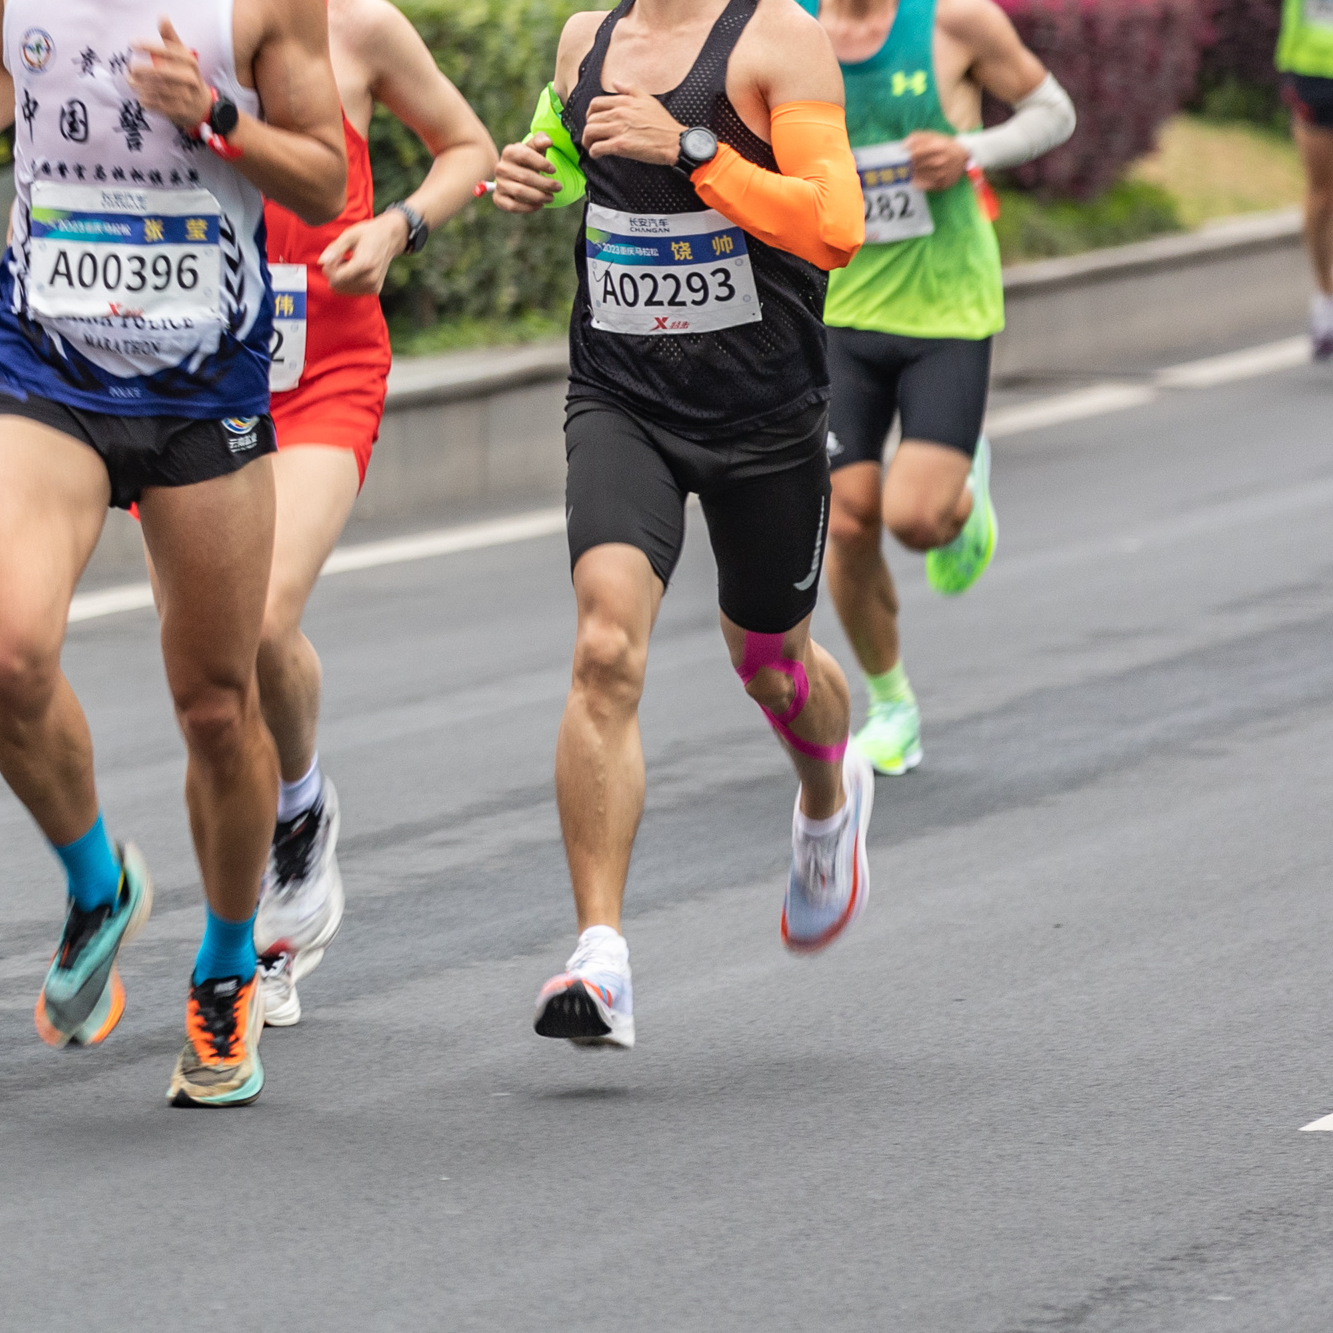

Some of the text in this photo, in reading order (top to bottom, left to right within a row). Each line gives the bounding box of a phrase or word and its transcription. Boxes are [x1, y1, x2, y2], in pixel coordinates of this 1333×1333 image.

[629, 218, 669, 227] 长安汽车
[49, 250, 200, 291] A00396
[602, 267, 736, 307] A02293
[275, 293, 294, 317] 伟
